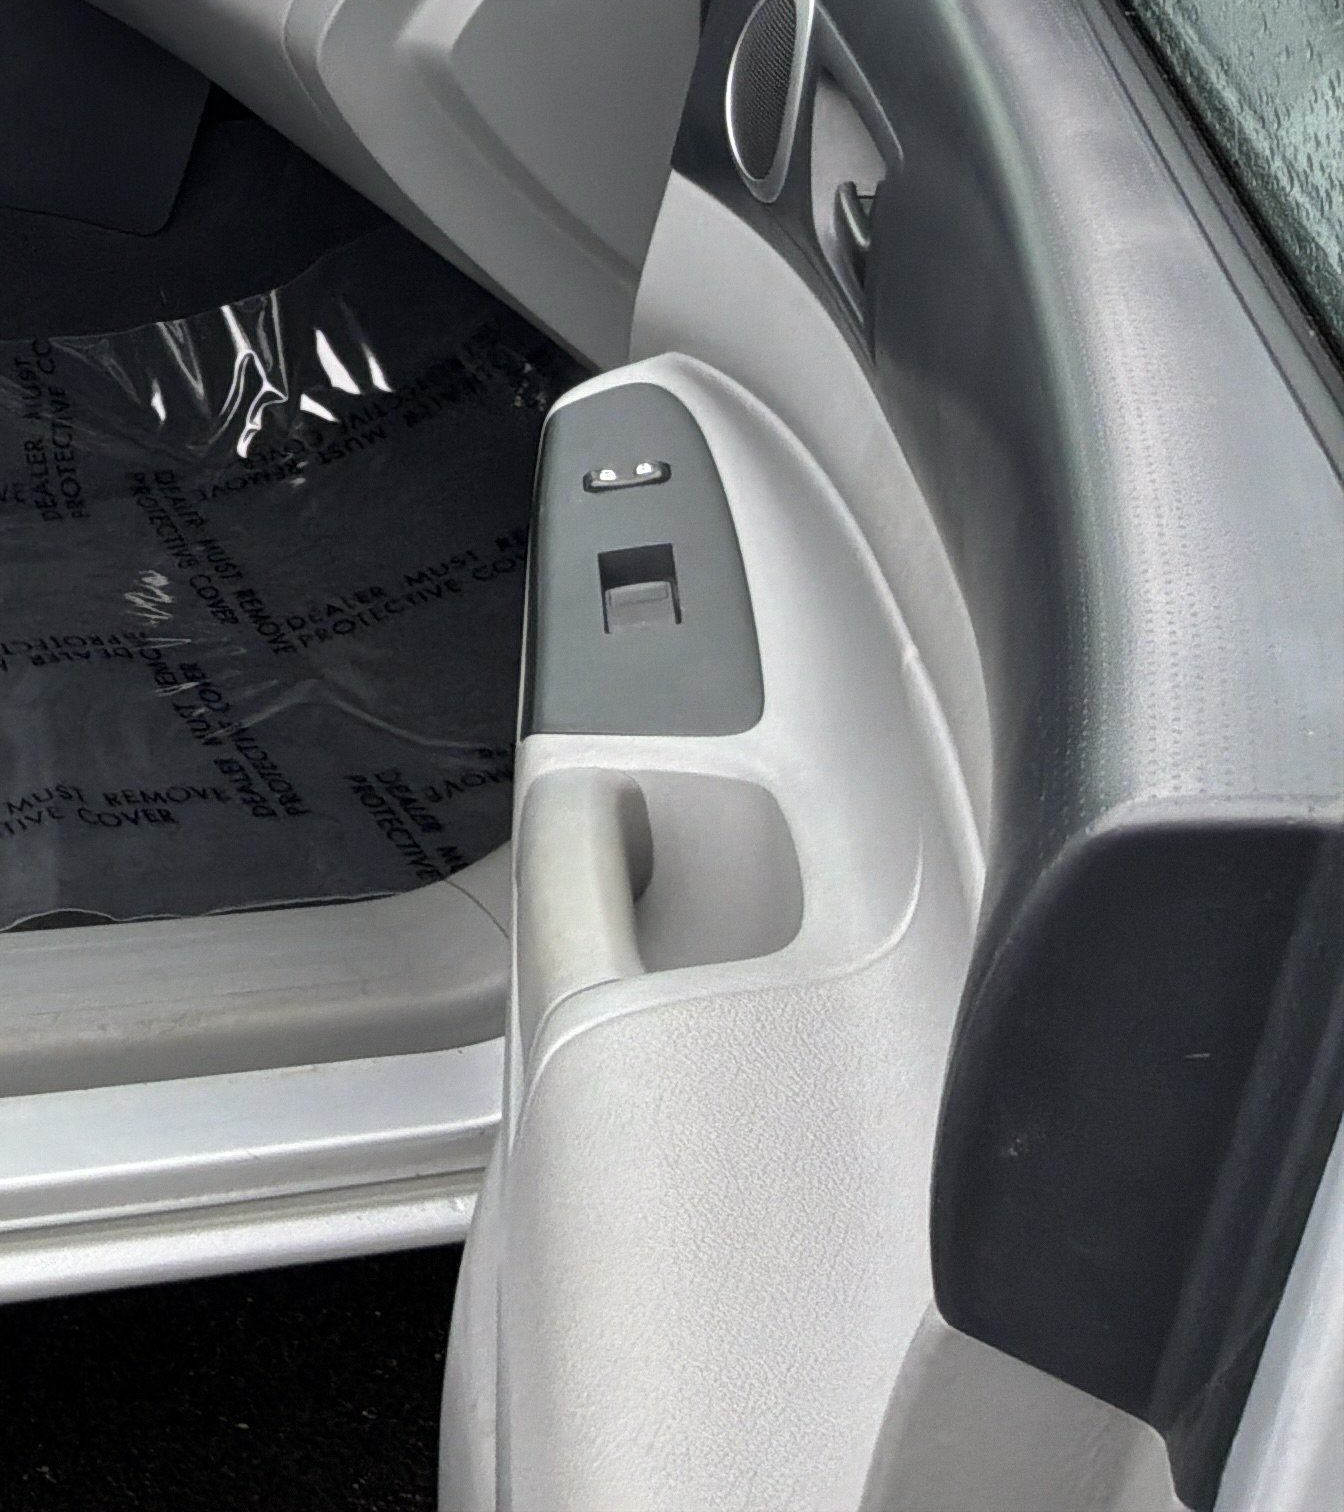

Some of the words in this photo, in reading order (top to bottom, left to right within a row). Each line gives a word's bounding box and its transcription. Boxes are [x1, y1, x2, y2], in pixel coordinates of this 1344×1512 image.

[24, 439, 63, 522] DEALER
[47, 386, 91, 519] PROTECTIVE
[188, 574, 240, 625] COVER
[235, 588, 298, 655] REMOVE
[286, 586, 387, 631] DEALER
[404, 550, 480, 587] MUST
[297, 578, 462, 649] PROTECTIVE
[32, 645, 133, 668] DEALER
[7, 785, 86, 816] MUST
[102, 786, 232, 810] REMOVE
[75, 806, 178, 829] COVER
